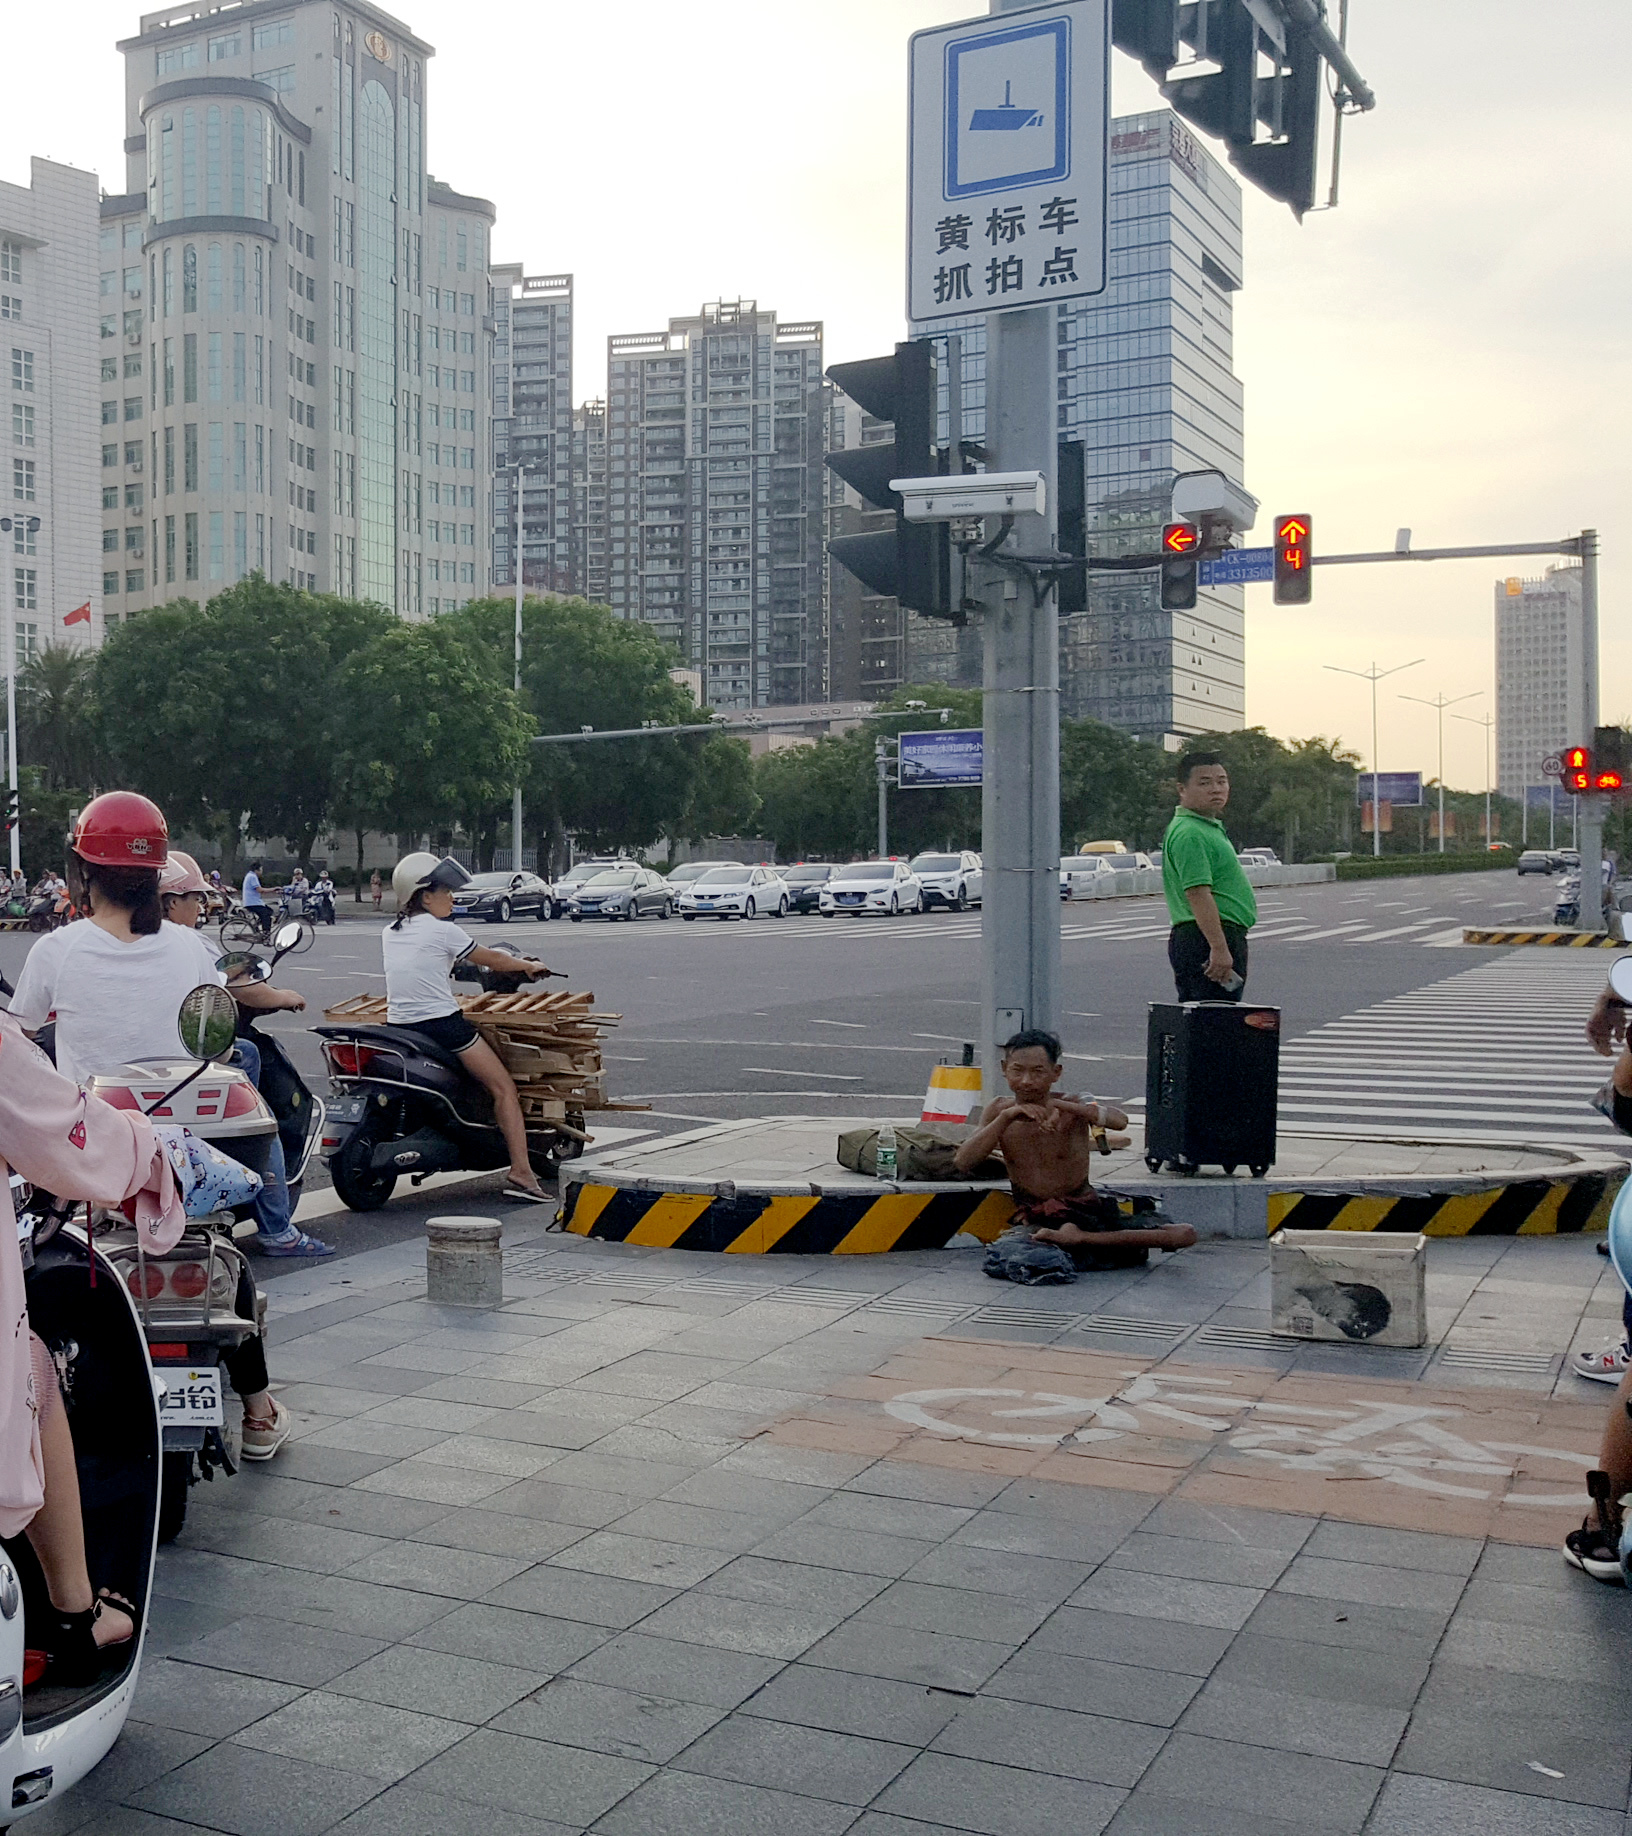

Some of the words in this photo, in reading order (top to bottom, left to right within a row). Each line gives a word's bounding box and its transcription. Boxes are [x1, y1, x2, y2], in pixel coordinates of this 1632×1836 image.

[935, 197, 1079, 254] 黄标车
[933, 246, 1079, 305] 抓拍点
[1285, 548, 1302, 570] 4
